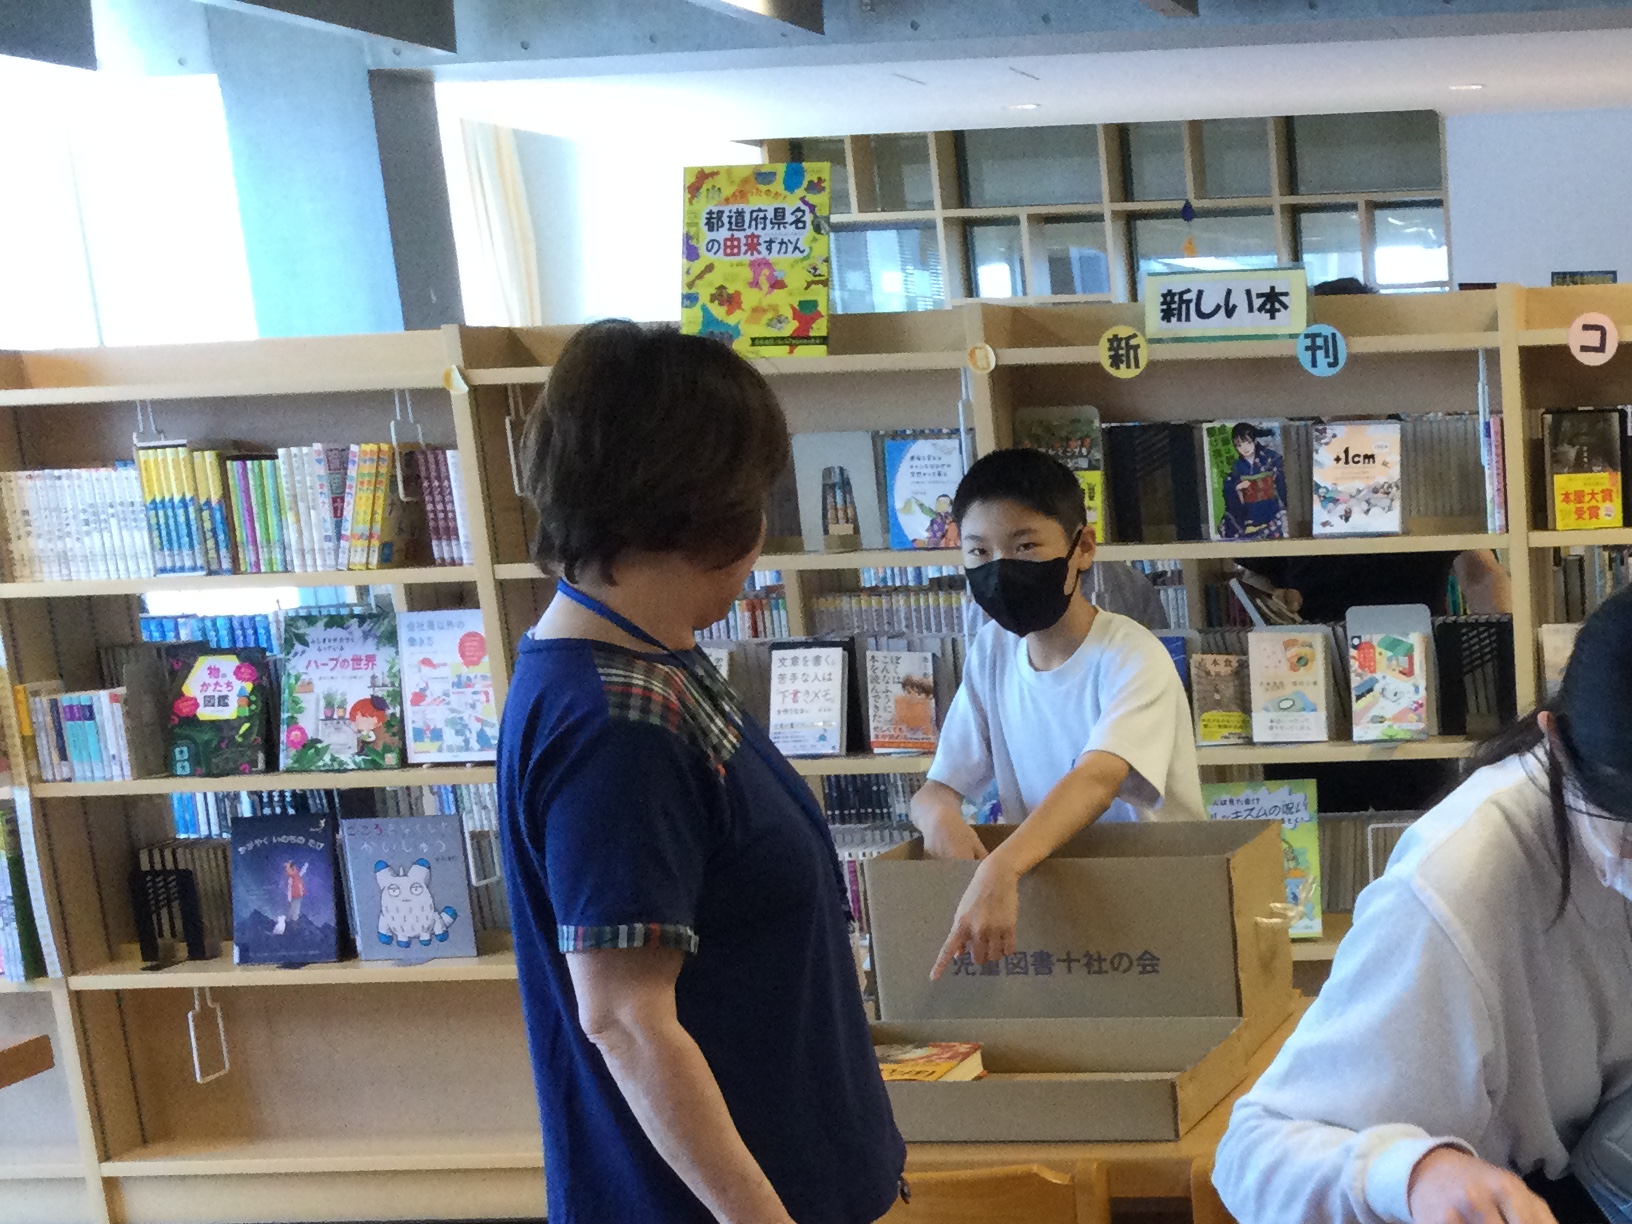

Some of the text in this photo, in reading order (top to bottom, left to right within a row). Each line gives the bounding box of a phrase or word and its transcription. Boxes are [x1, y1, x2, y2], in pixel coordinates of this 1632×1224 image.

[704, 206, 807, 232] 都道府県名
[705, 232, 806, 257] の由来ずかん
[1159, 285, 1291, 324] 新しい本
[1106, 333, 1142, 371] 新
[1303, 332, 1339, 369] 刊
[1579, 323, 1607, 354] コ
[1333, 446, 1377, 466] +1cm
[1561, 488, 1614, 504] 本屋大賞
[305, 653, 377, 671] ハーブの世界
[199, 680, 235, 693] かたち
